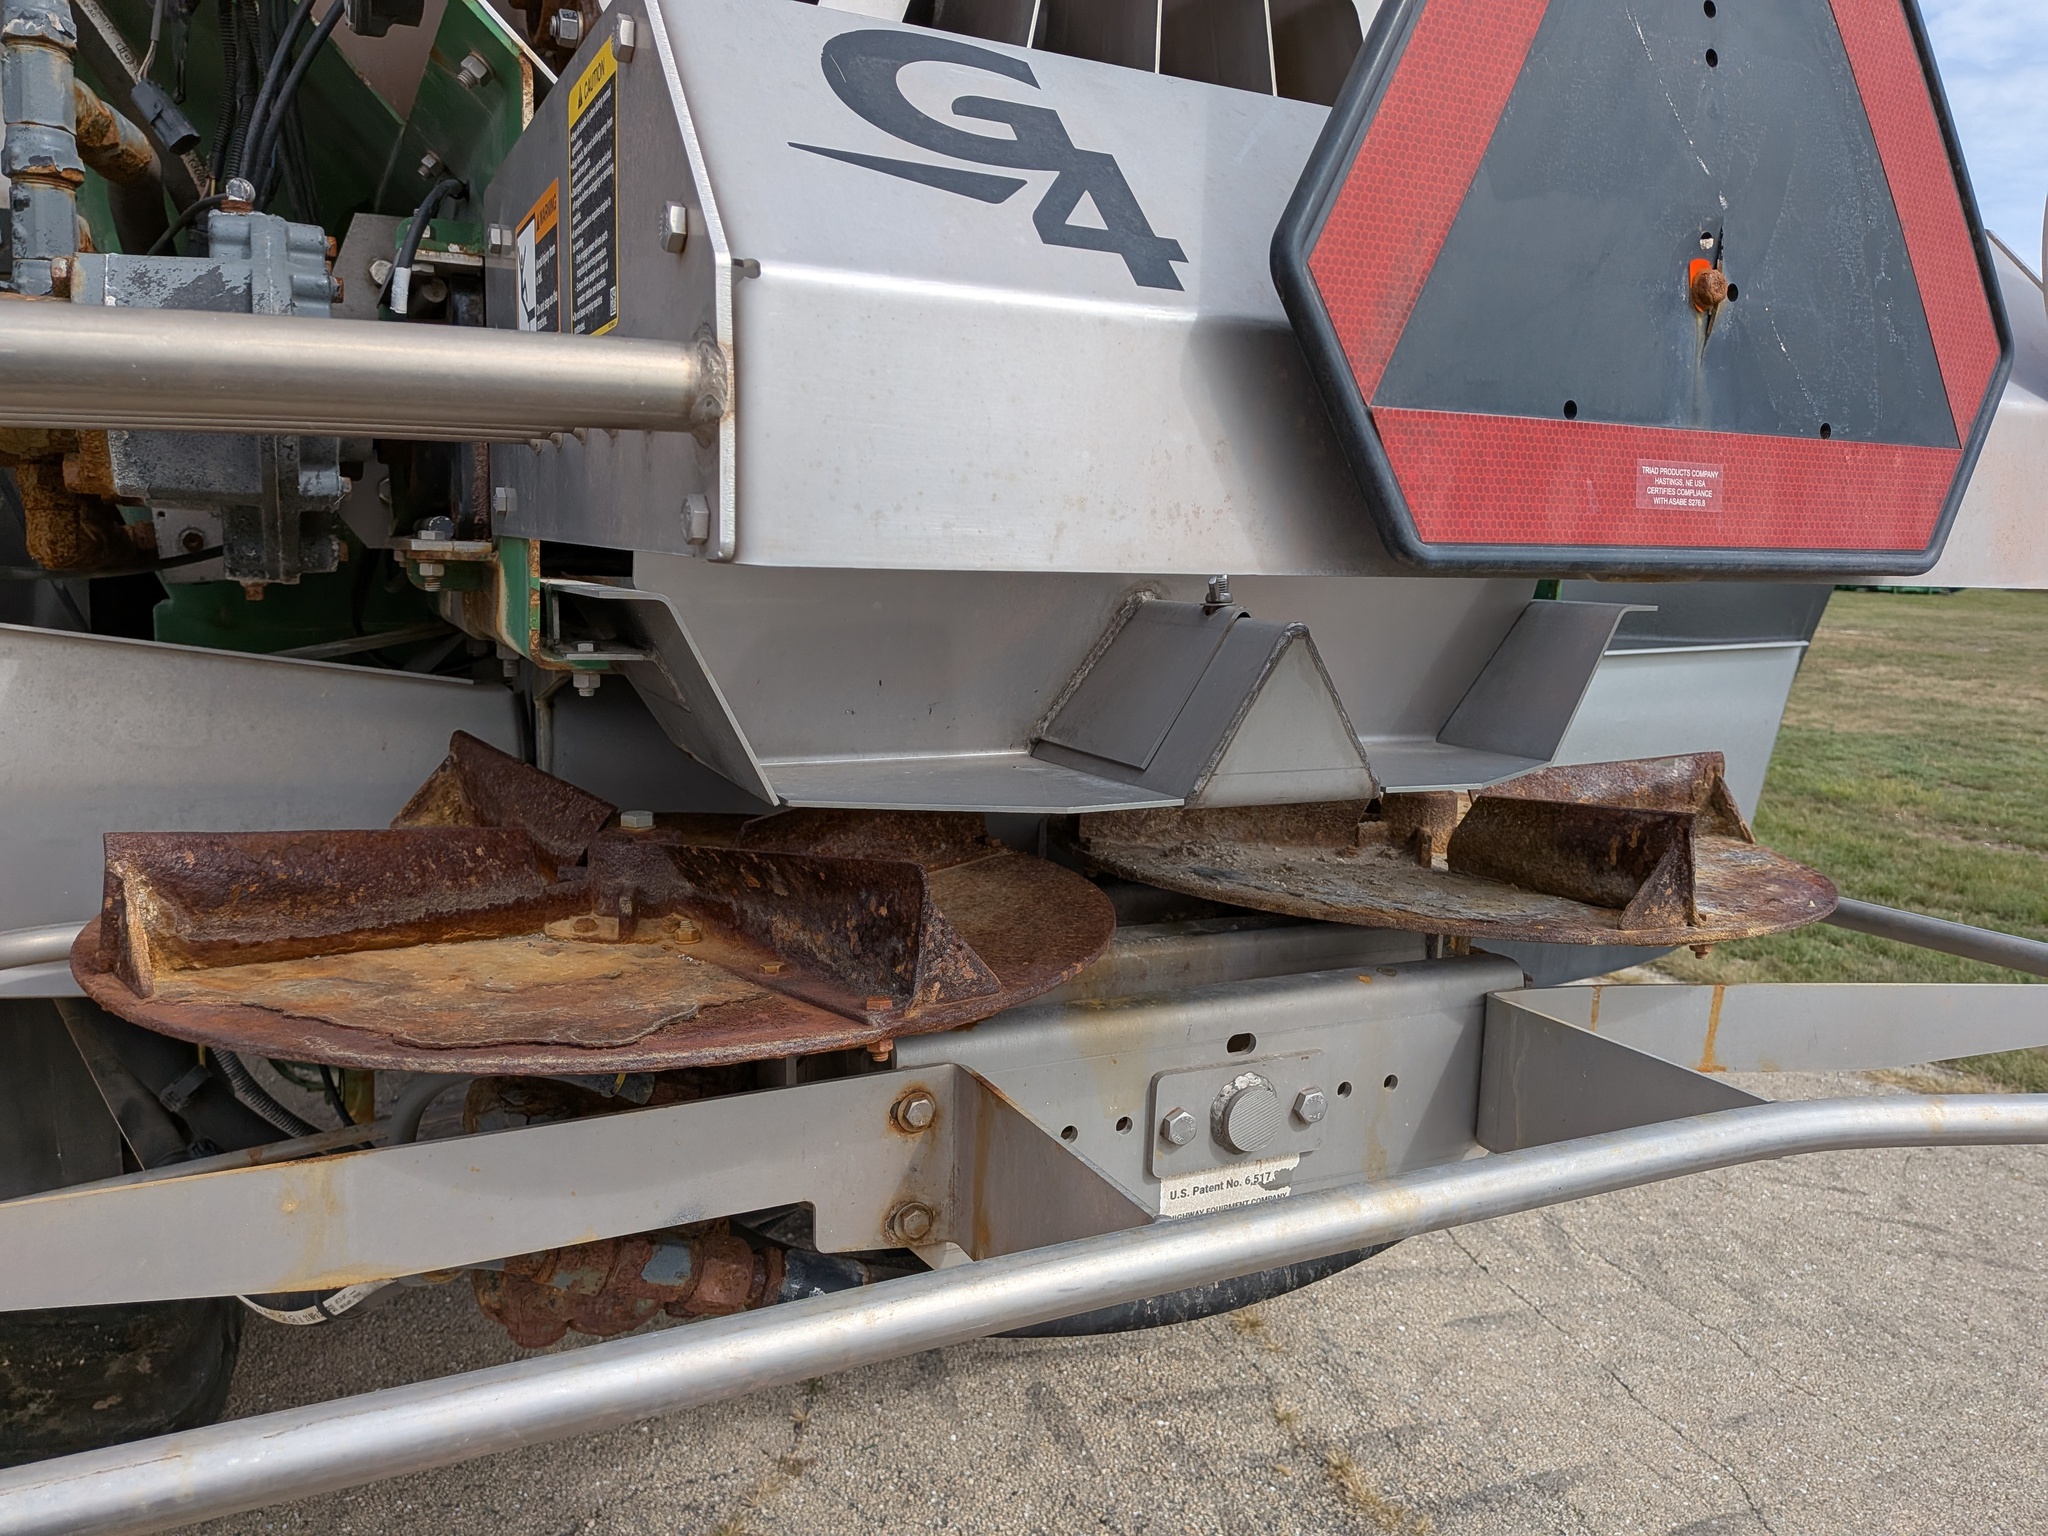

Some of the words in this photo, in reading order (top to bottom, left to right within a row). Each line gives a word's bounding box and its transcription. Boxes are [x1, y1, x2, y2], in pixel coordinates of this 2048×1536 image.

[583, 56, 606, 100] CAUTION
[821, 30, 1190, 292] G4
[539, 193, 557, 224] WARNING
[1642, 466, 1659, 475] TRIAD
[1660, 467, 1691, 477] PRODUCTS
[1691, 469, 1719, 478] COMPANY
[1654, 477, 1685, 487] HASTINGS,
[1685, 479, 1693, 487] NE
[1646, 486, 1676, 495] CERTIFIES
[1676, 488, 1713, 498] COMPLIANCE
[1653, 497, 1668, 505] WITH
[1668, 497, 1687, 506] ASABE
[1170, 1189, 1190, 1200] U.S.
[1192, 1181, 1225, 1196] Patent
[1226, 1179, 1242, 1189] No.
